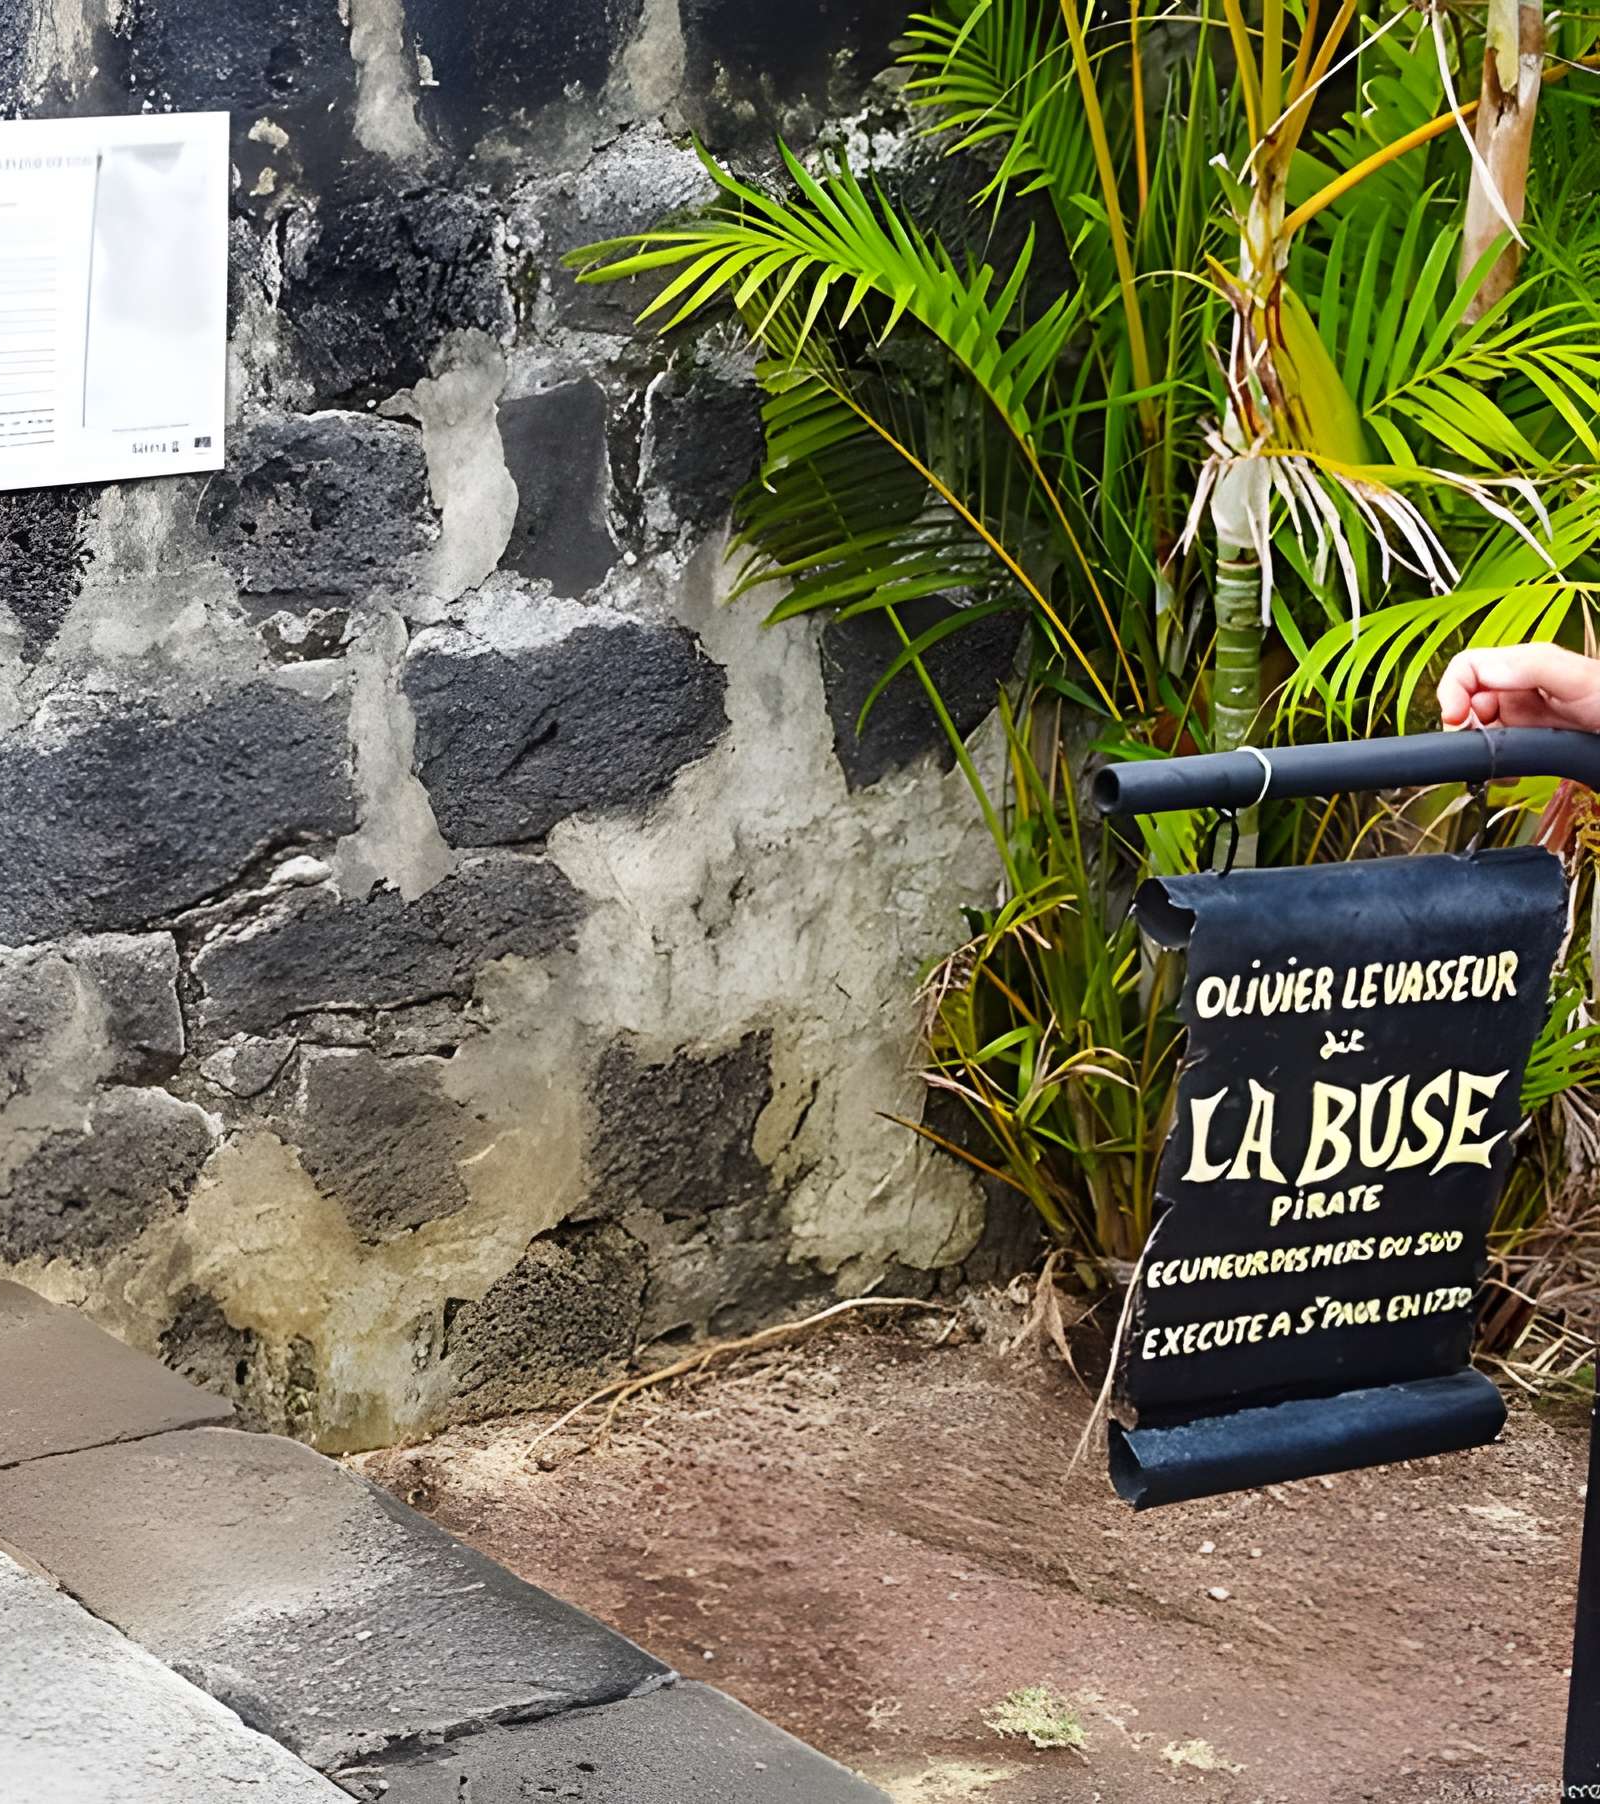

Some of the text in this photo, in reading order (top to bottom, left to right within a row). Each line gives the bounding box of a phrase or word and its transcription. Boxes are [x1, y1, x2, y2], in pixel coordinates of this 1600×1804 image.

[1196, 957, 1334, 1018] OLIVIER
[1180, 1069, 1510, 1187] LA BUSE
[1270, 1184, 1384, 1227] PIRATE
[1142, 1313, 1268, 1360] EXECUTE
[1268, 1311, 1291, 1338] A
